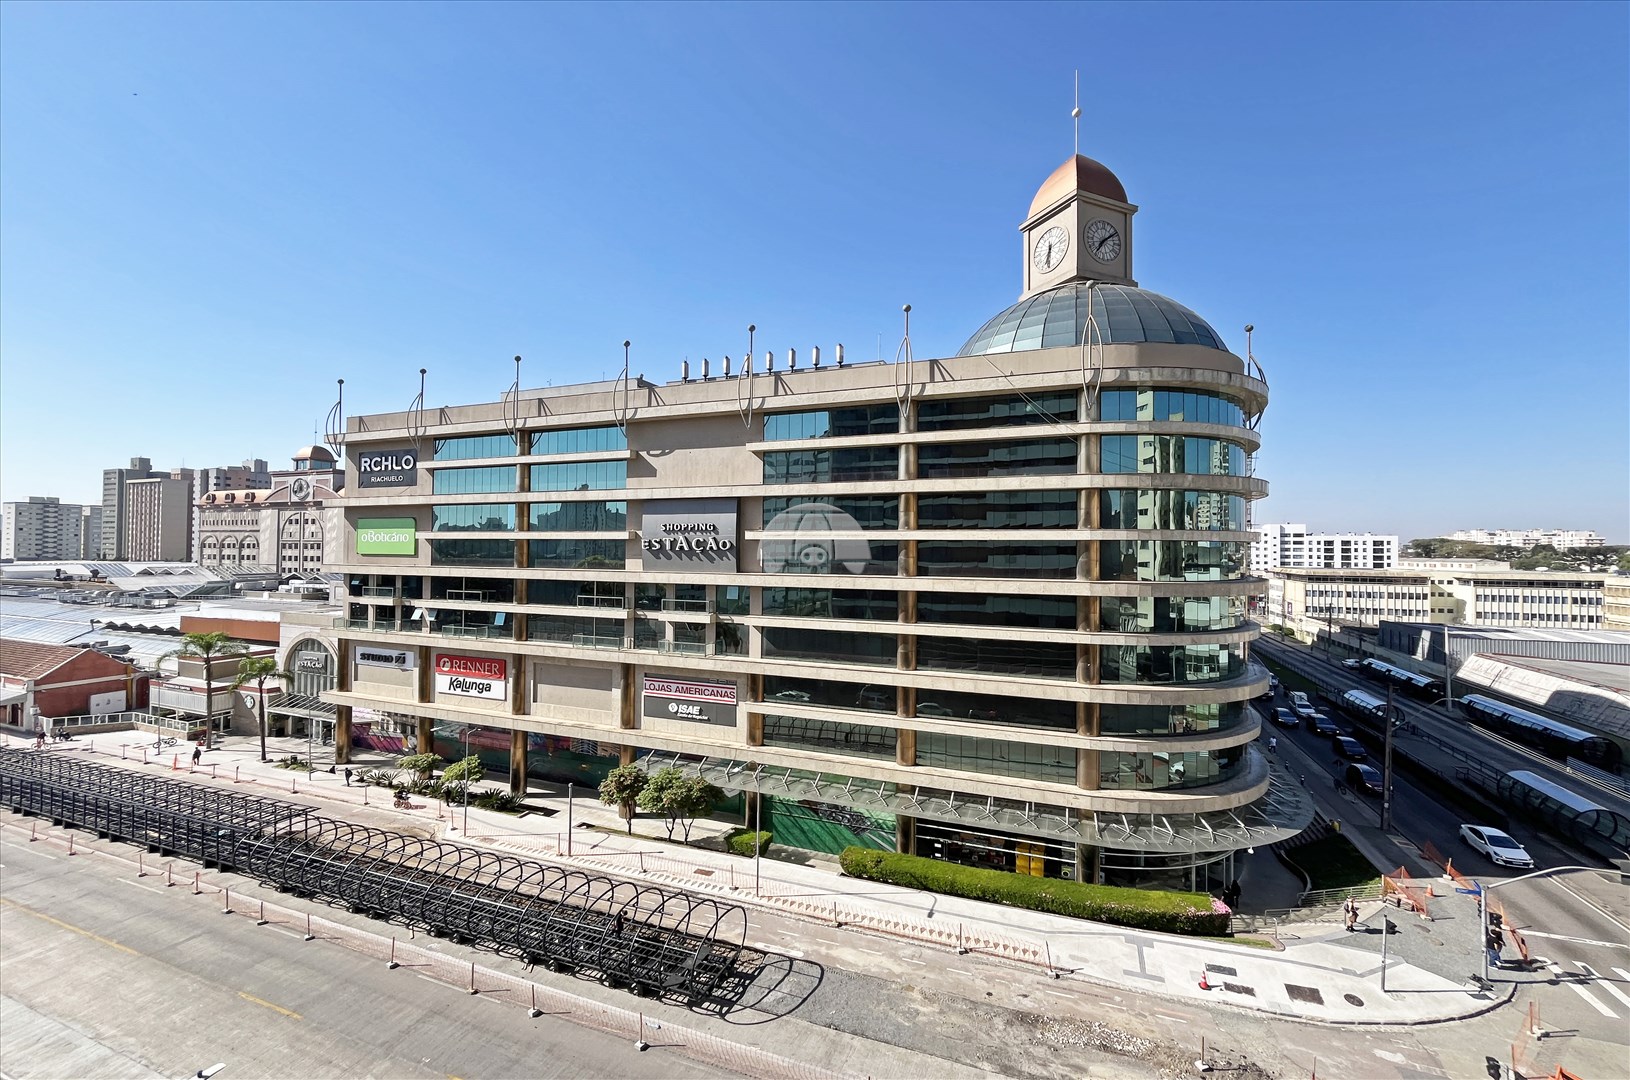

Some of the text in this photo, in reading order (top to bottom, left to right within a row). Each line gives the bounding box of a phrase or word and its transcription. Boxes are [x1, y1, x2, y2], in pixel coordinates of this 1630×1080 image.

[361, 455, 414, 472] RCHLO
[370, 475, 404, 483] RIACHUELO
[660, 522, 714, 531] SHOPPING
[641, 536, 730, 553] ESTAÇÃO
[360, 652, 394, 663] STUDIO
[452, 659, 500, 675] RENNER
[644, 682, 736, 699] LOJAS AMERICANAS
[678, 704, 701, 715] ISAE
